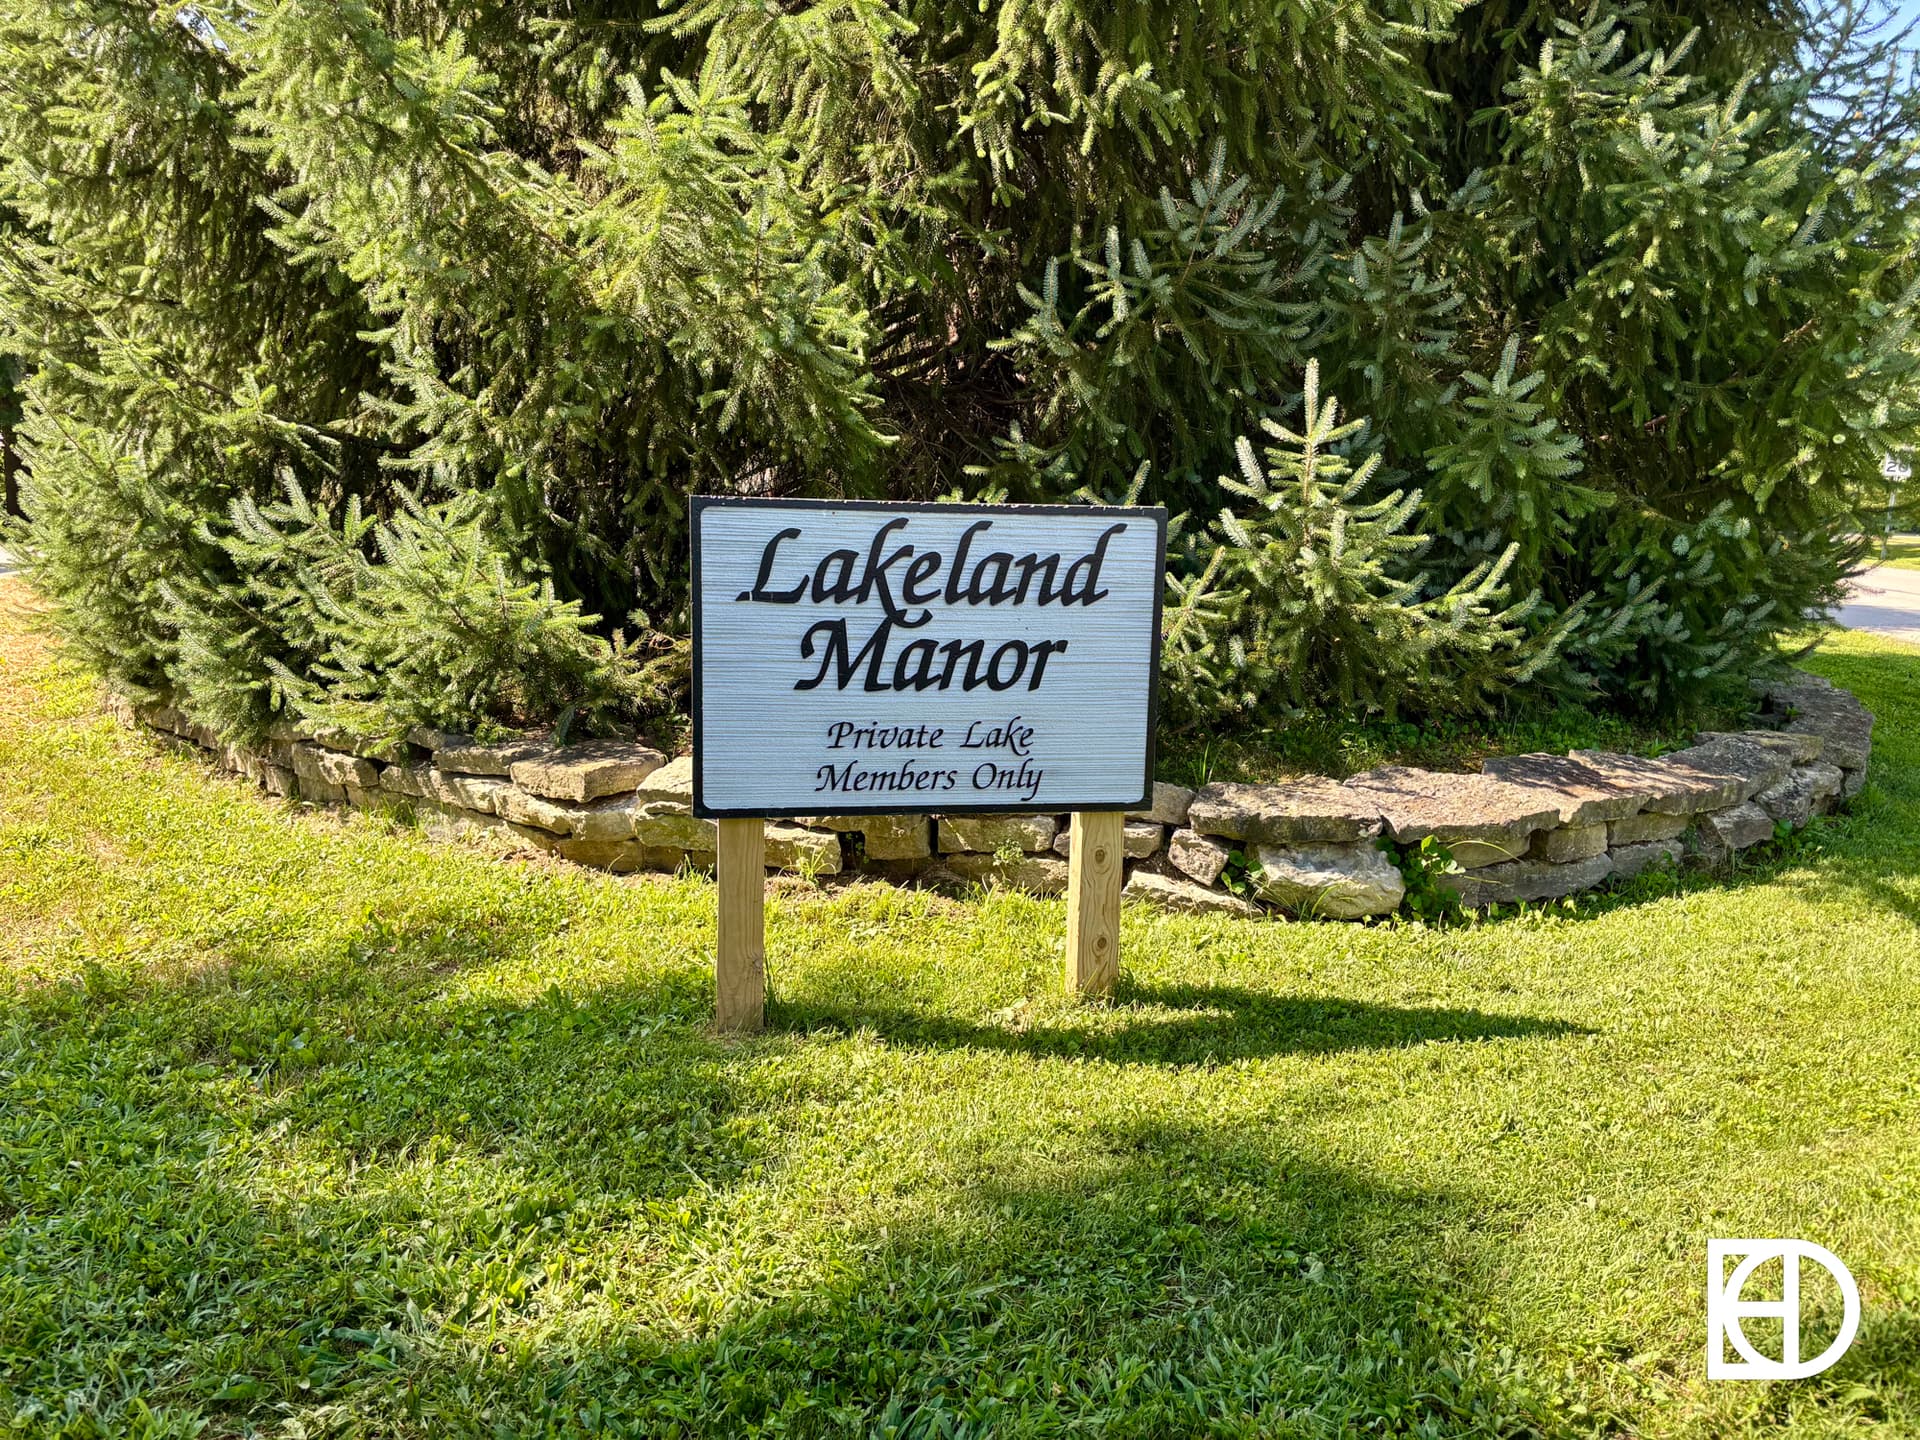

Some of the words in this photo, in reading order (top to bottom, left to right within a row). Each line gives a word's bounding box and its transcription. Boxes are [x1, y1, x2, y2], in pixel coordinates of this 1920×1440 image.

[736, 517, 1128, 627] Lakeland
[794, 614, 1068, 692] Manor
[827, 721, 944, 750] Private
[961, 716, 1035, 756] Lake
[815, 760, 956, 792] Members
[972, 759, 1043, 801] Only
